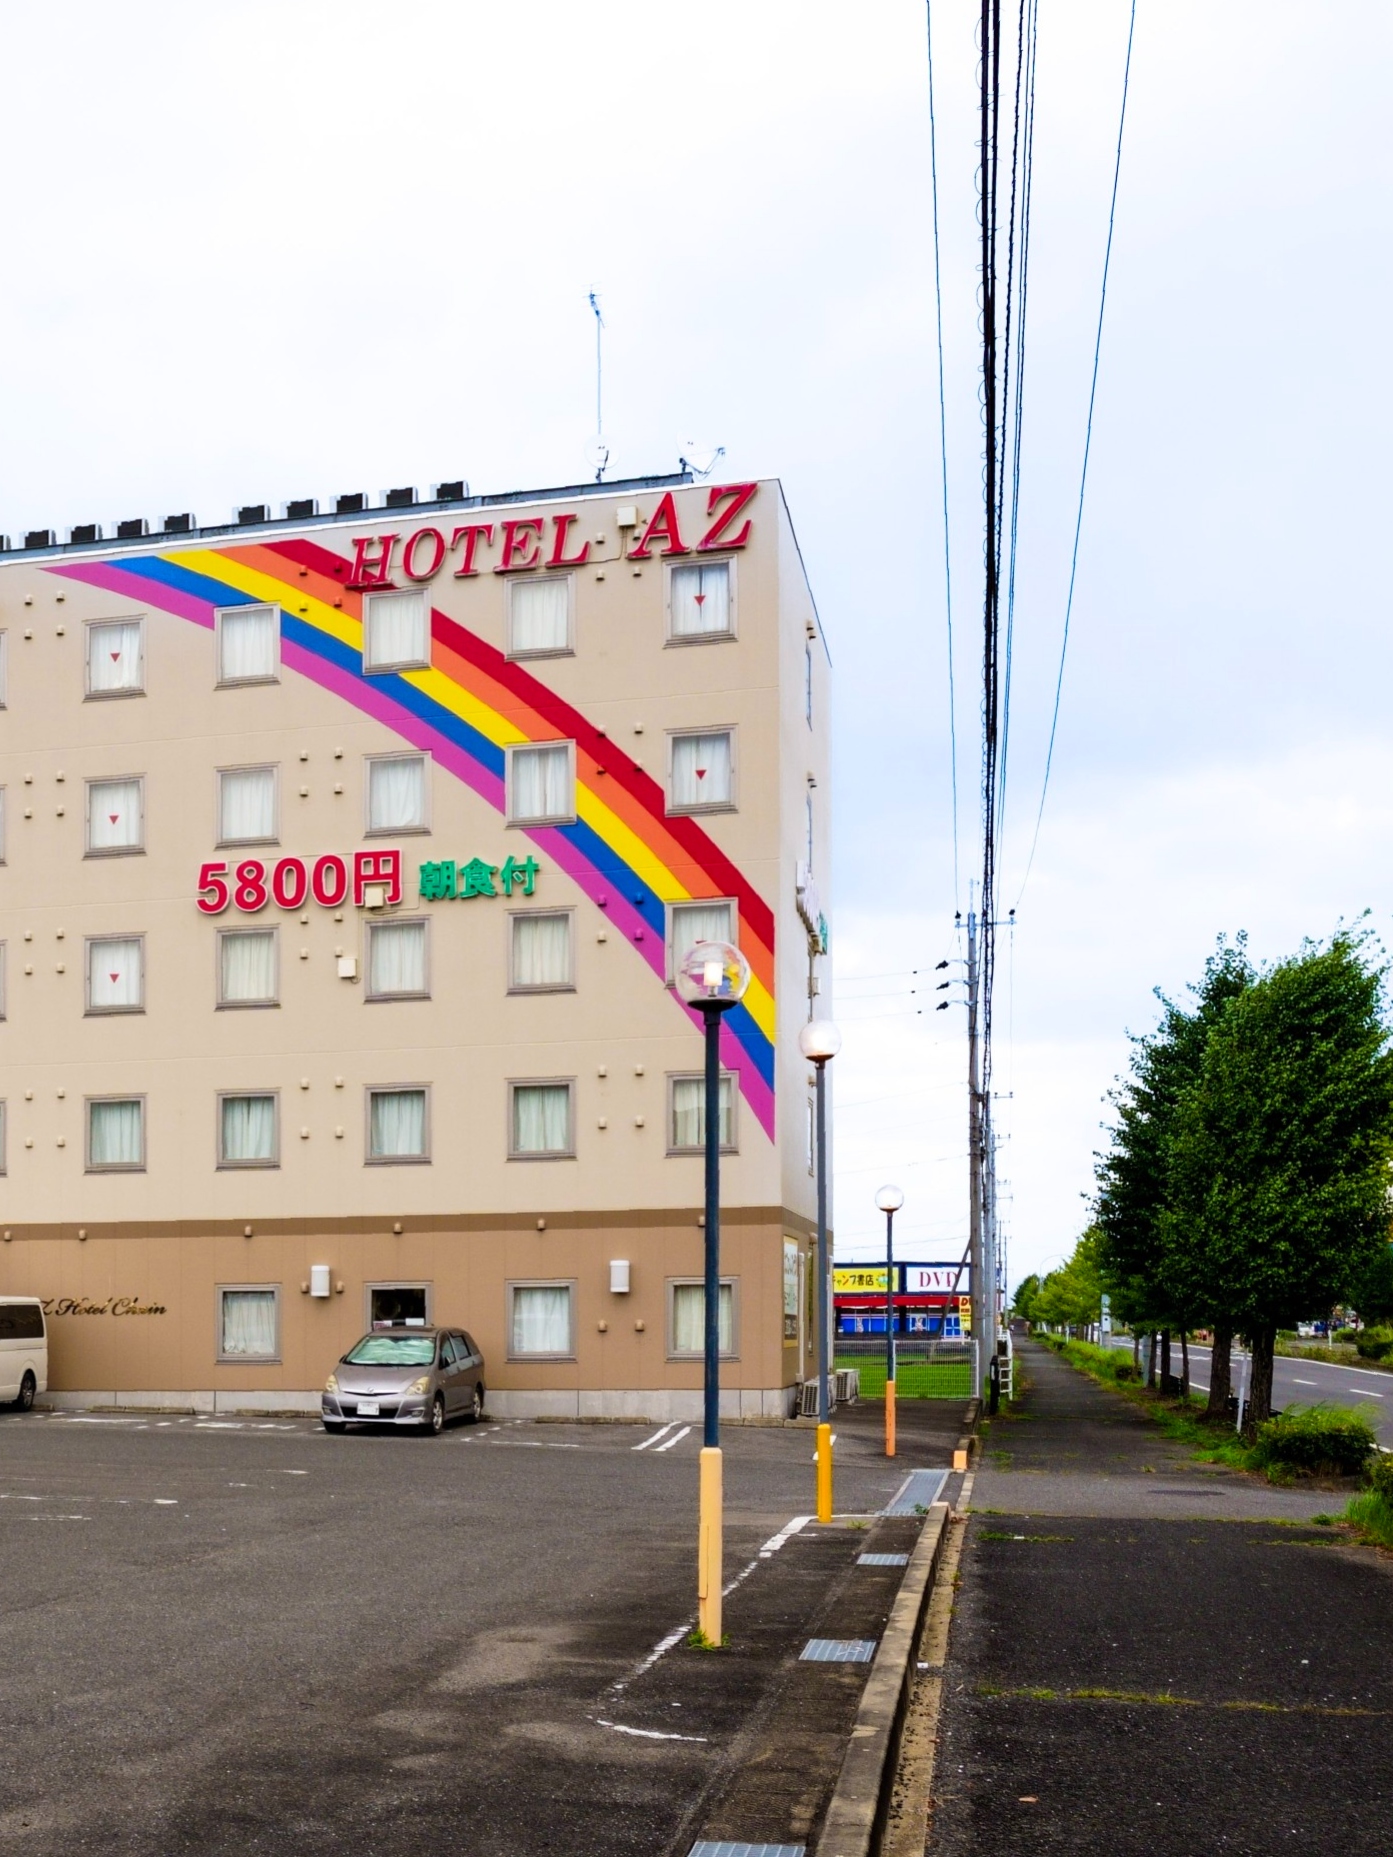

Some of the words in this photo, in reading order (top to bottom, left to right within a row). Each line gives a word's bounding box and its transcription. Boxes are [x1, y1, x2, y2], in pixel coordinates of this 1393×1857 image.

[344, 513, 591, 588] HOTEL
[626, 482, 758, 559] AZ
[196, 848, 402, 914] 5800円
[418, 855, 540, 901] 朝食付
[55, 1297, 113, 1316] Hotel
[111, 1297, 167, 1316] Chain
